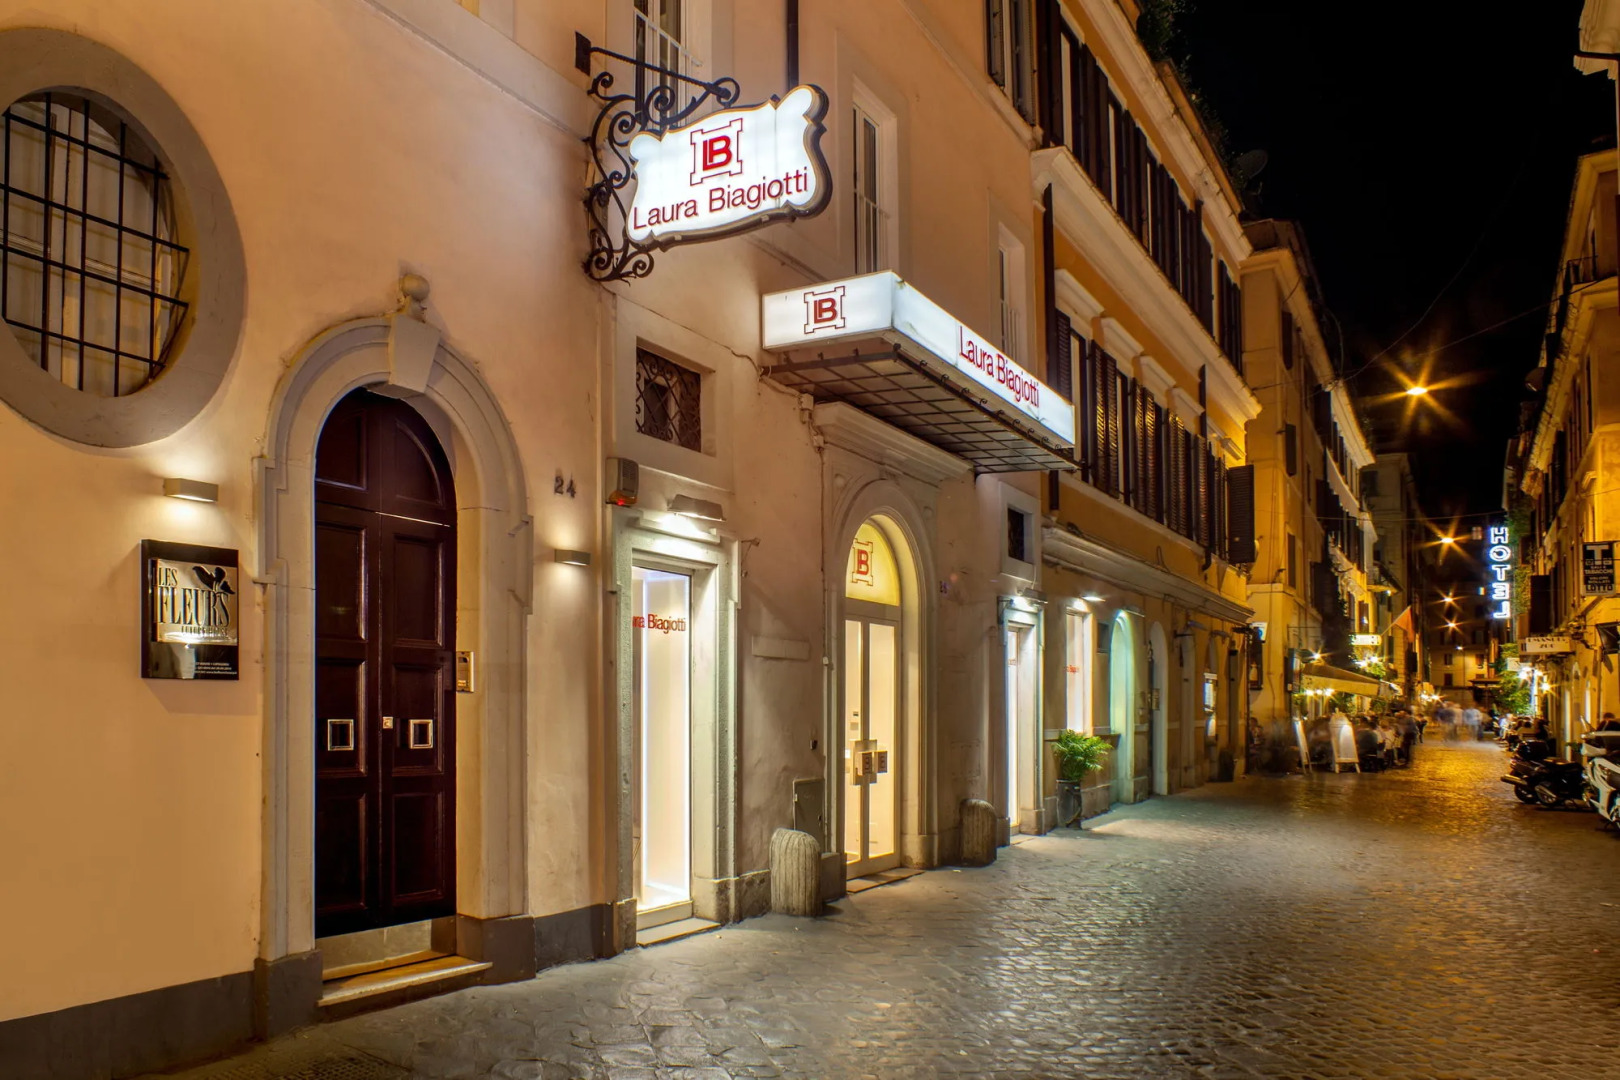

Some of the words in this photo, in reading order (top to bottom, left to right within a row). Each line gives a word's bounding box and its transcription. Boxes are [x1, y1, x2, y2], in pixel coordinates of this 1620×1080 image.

[633, 198, 699, 231] Laura
[708, 166, 809, 214] Biagiotti
[959, 325, 994, 377] Laura
[996, 353, 1040, 409] Biagiotti
[553, 475, 577, 499] 24
[158, 567, 178, 587] LES
[158, 586, 230, 629] FLEURS
[647, 613, 687, 635] Biagiotti
